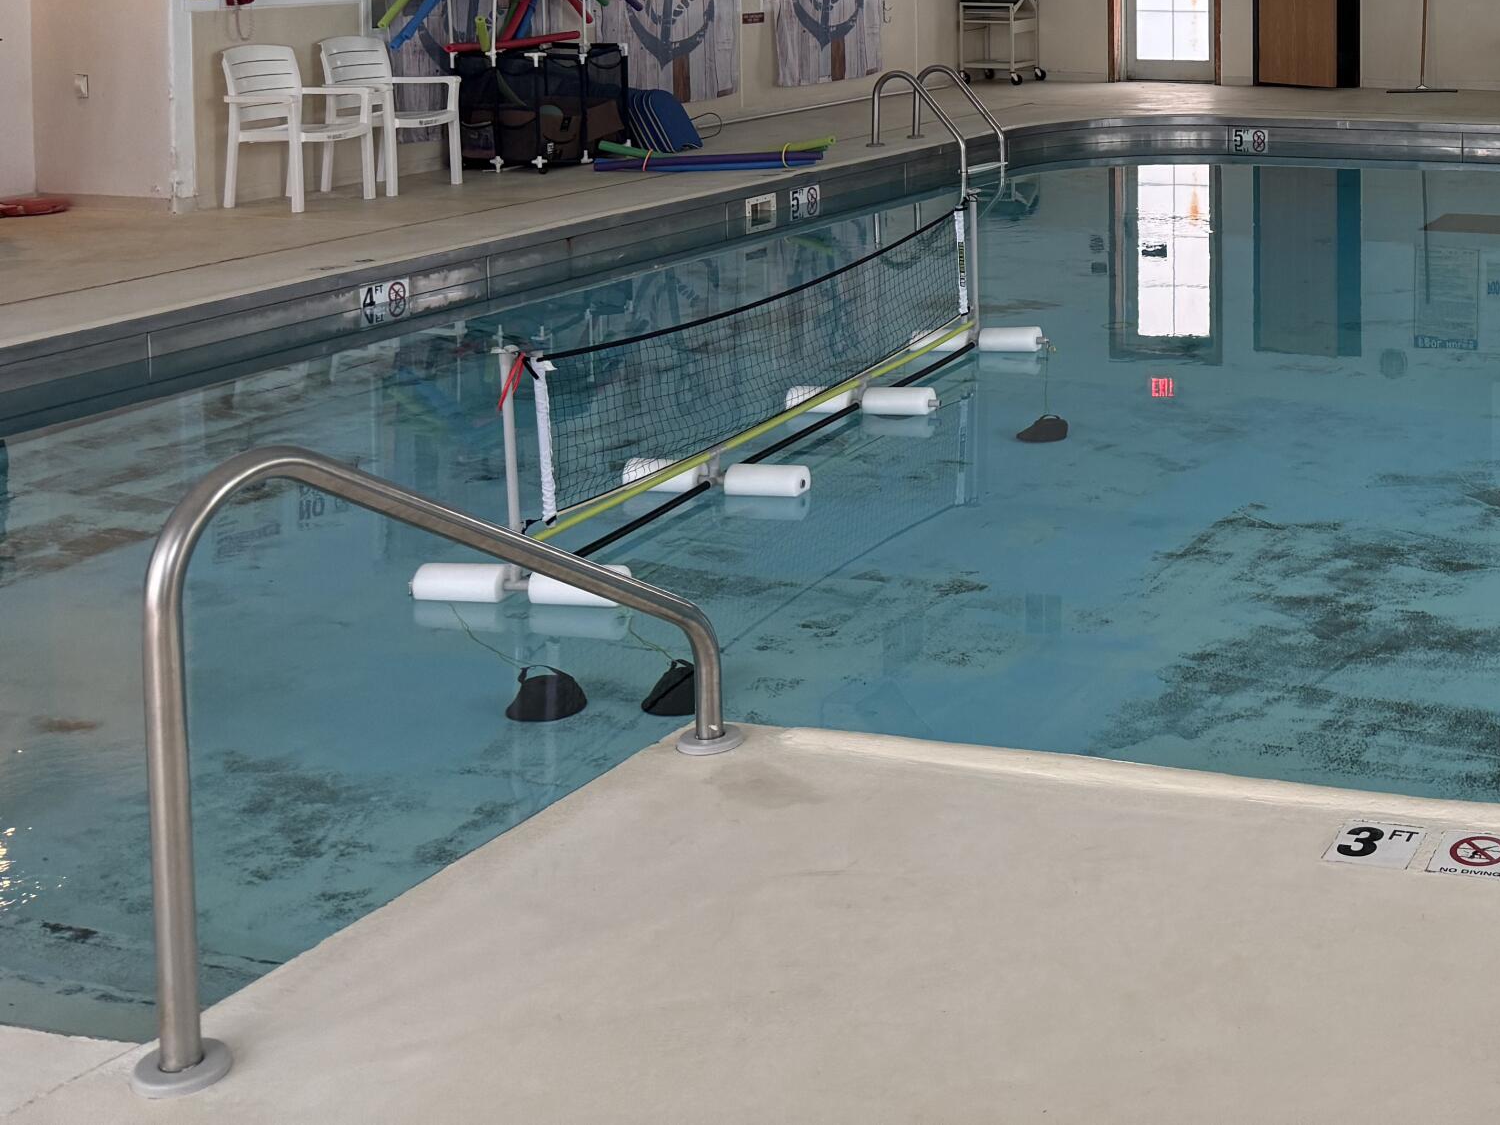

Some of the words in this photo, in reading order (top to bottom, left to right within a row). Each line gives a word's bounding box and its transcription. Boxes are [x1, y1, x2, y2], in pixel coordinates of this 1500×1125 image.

[363, 286, 376, 308] 4
[375, 284, 384, 295] FT
[1336, 826, 1385, 857] 3
[1388, 829, 1420, 843] FT
[1461, 868, 1500, 877] DIVING
